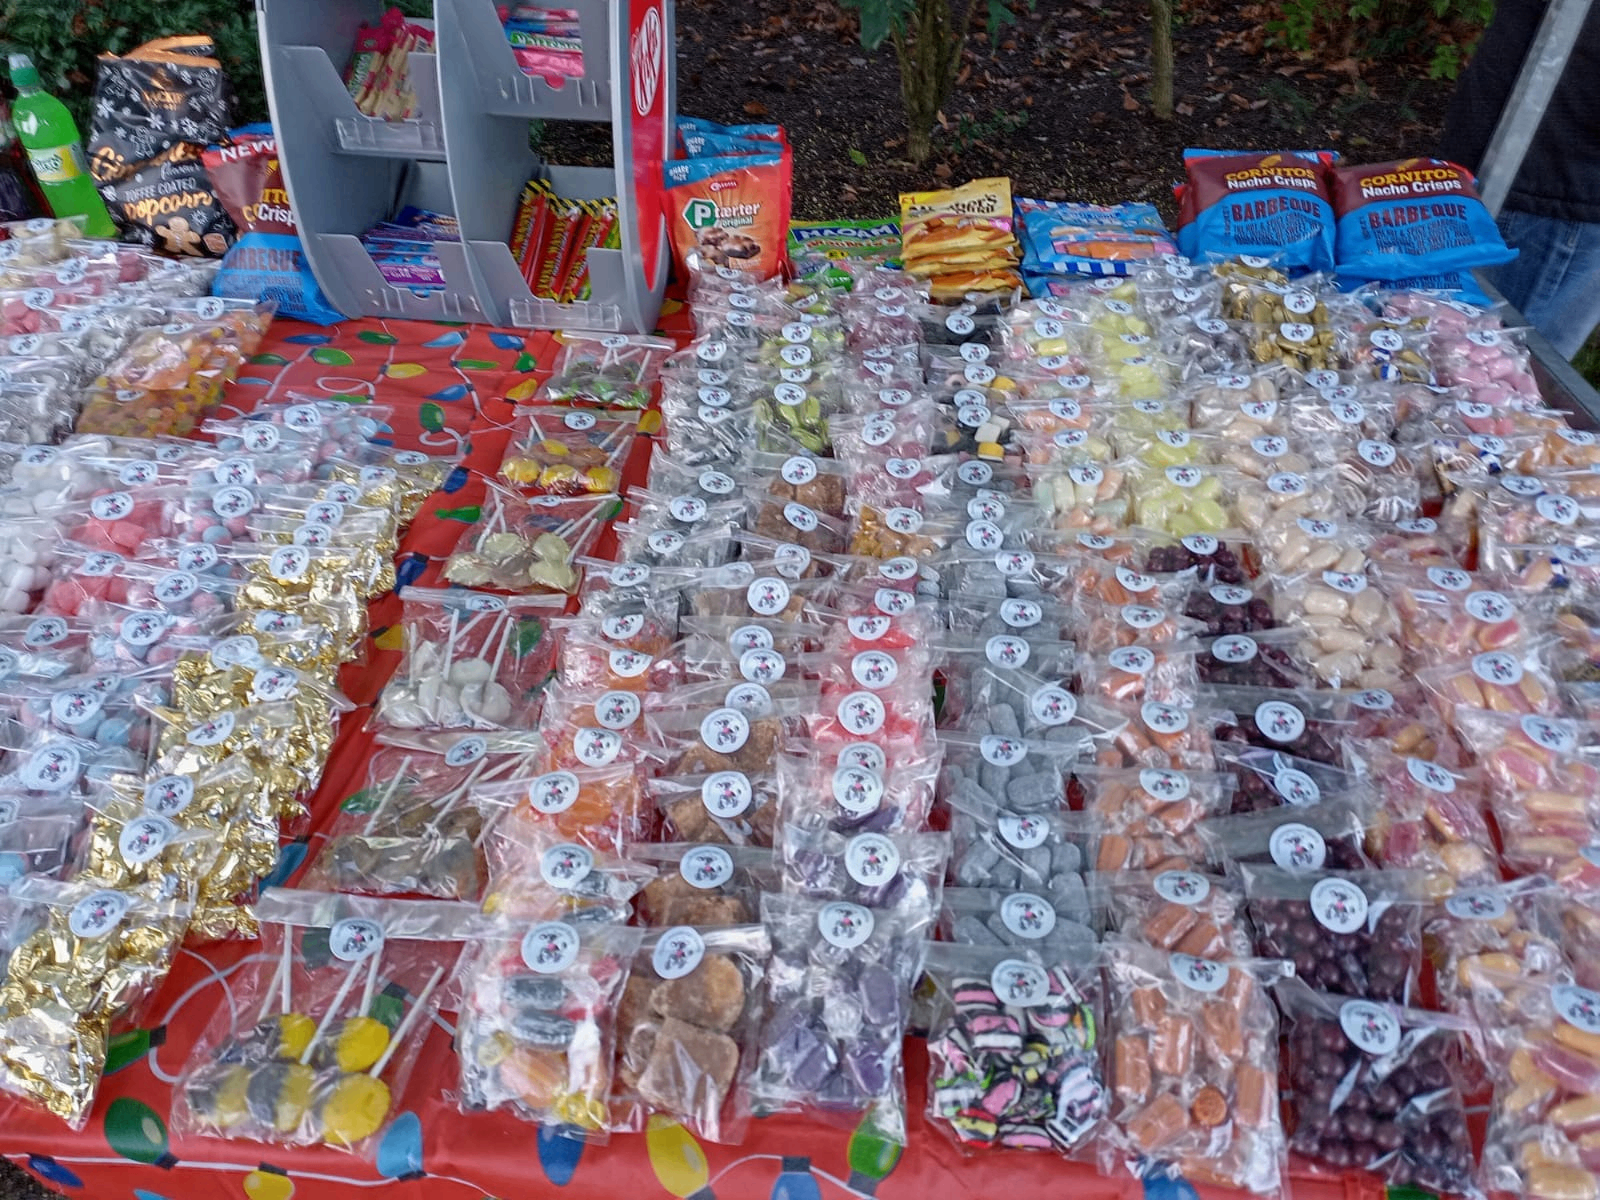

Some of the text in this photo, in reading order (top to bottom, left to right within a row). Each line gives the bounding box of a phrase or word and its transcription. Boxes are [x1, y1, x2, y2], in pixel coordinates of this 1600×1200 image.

[1225, 167, 1316, 182] CORNITOS
[1227, 175, 1318, 191] Nacho Crisps
[1360, 168, 1460, 188] CORNITOS
[1362, 179, 1462, 199] Nacho Crisps
[258, 203, 296, 227] Crisp
[1231, 195, 1322, 222] BARBEQUE
[1368, 202, 1468, 229] BARBEQUE
[799, 224, 894, 239] MAOAM
[229, 247, 303, 272] ARBEQUE
